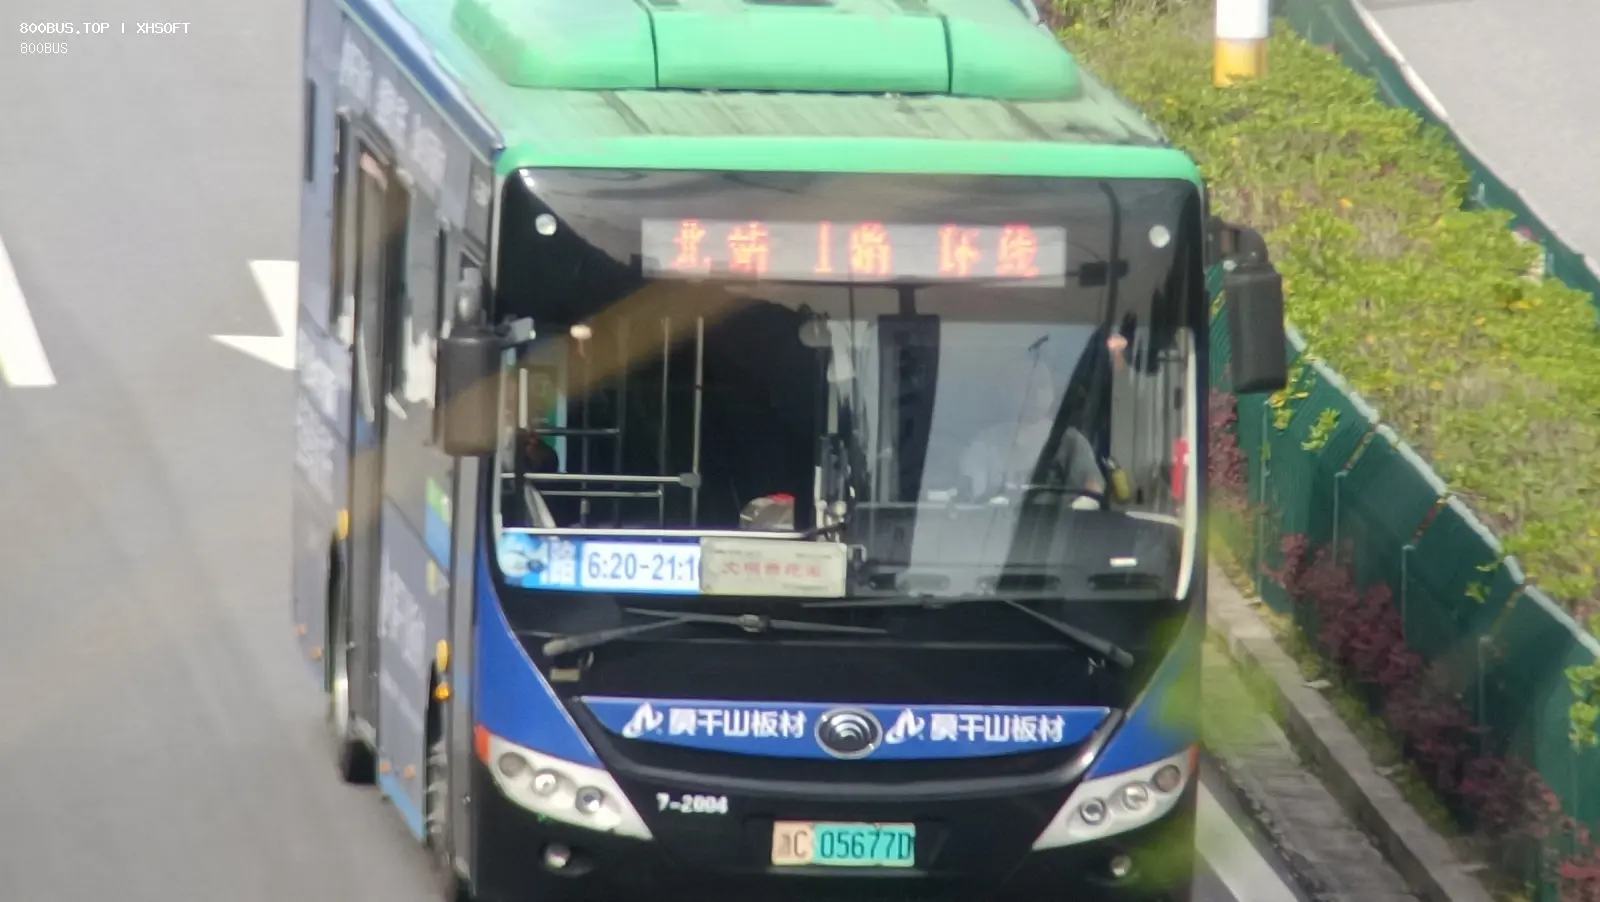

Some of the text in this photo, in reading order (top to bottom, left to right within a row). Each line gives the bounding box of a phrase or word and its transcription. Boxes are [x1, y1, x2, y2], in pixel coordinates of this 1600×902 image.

[587, 552, 702, 581] 6:20-21:1
[657, 793, 730, 815] 7-2004
[819, 831, 913, 859] 05677D
